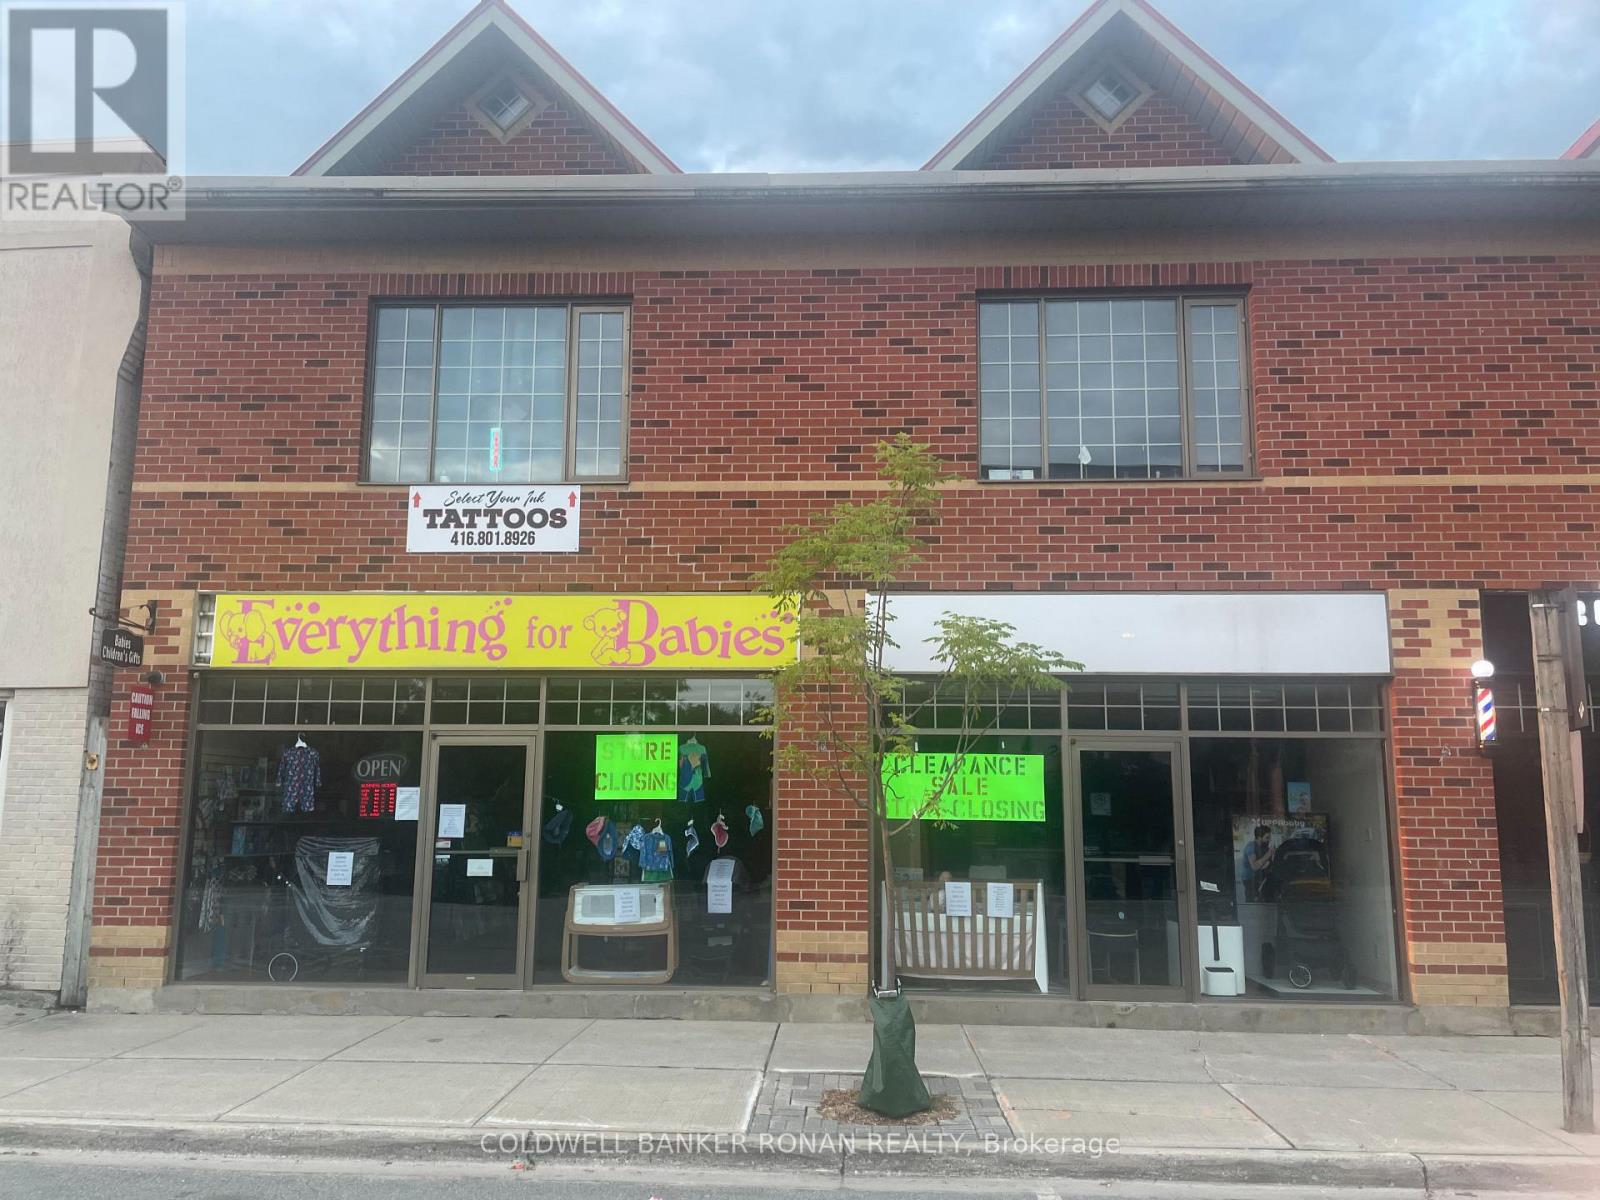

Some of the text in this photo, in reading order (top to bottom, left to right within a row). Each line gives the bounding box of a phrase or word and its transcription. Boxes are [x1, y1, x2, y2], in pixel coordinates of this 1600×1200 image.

[444, 490, 545, 508] Select Your Ink
[423, 508, 568, 529] TATTOOS
[450, 531, 536, 546] 416.801.8926
[114, 634, 132, 649] Babies
[231, 598, 785, 667] Everything for Babies
[102, 645, 141, 665] Children's Gifts
[131, 692, 153, 705] CAUTION
[131, 707, 151, 720] FALLING
[135, 723, 145, 735] ICE
[357, 759, 401, 777] OPEN
[894, 754, 1026, 776] CLEARANCE
[595, 772, 676, 791] CLOSING
[931, 776, 989, 796] SALE
[952, 800, 1045, 820] CLOSING
